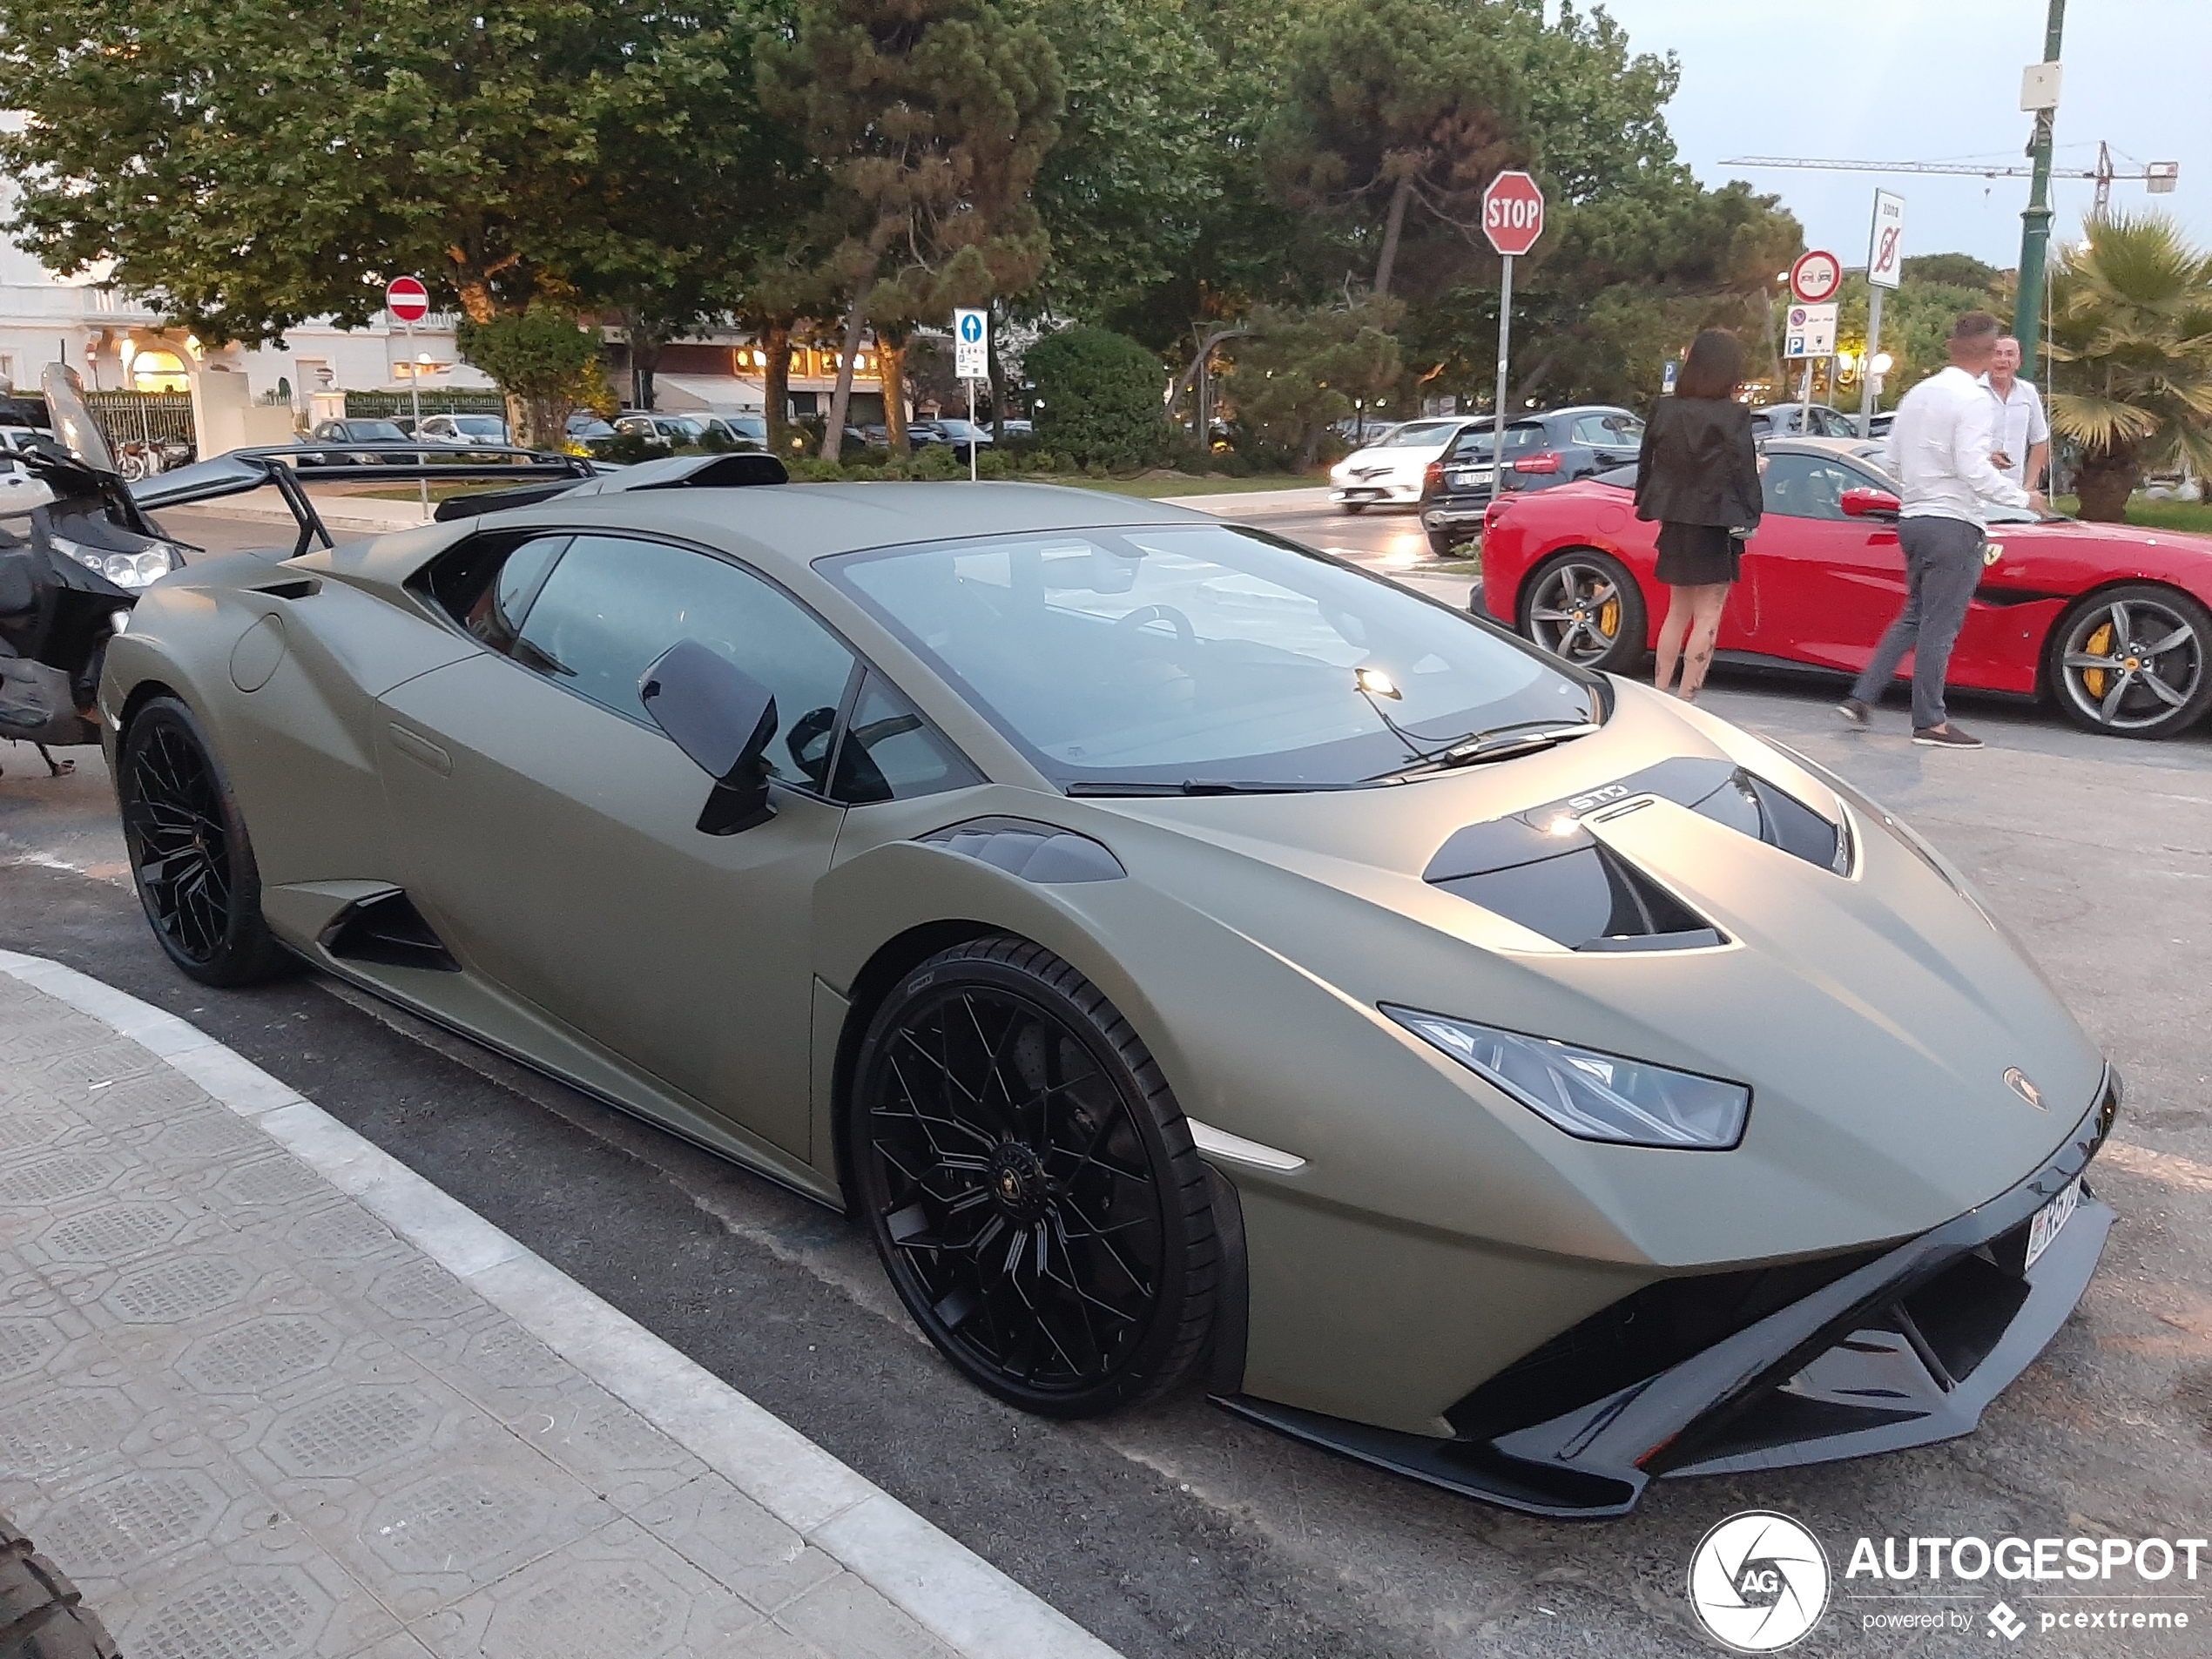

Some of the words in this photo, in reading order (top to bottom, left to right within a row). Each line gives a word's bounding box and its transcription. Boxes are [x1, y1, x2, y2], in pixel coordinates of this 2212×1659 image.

[1487, 197, 1539, 229] STOP
[1791, 338, 1803, 354] P
[1664, 364, 1673, 381] P
[1568, 785, 1629, 810] STO
